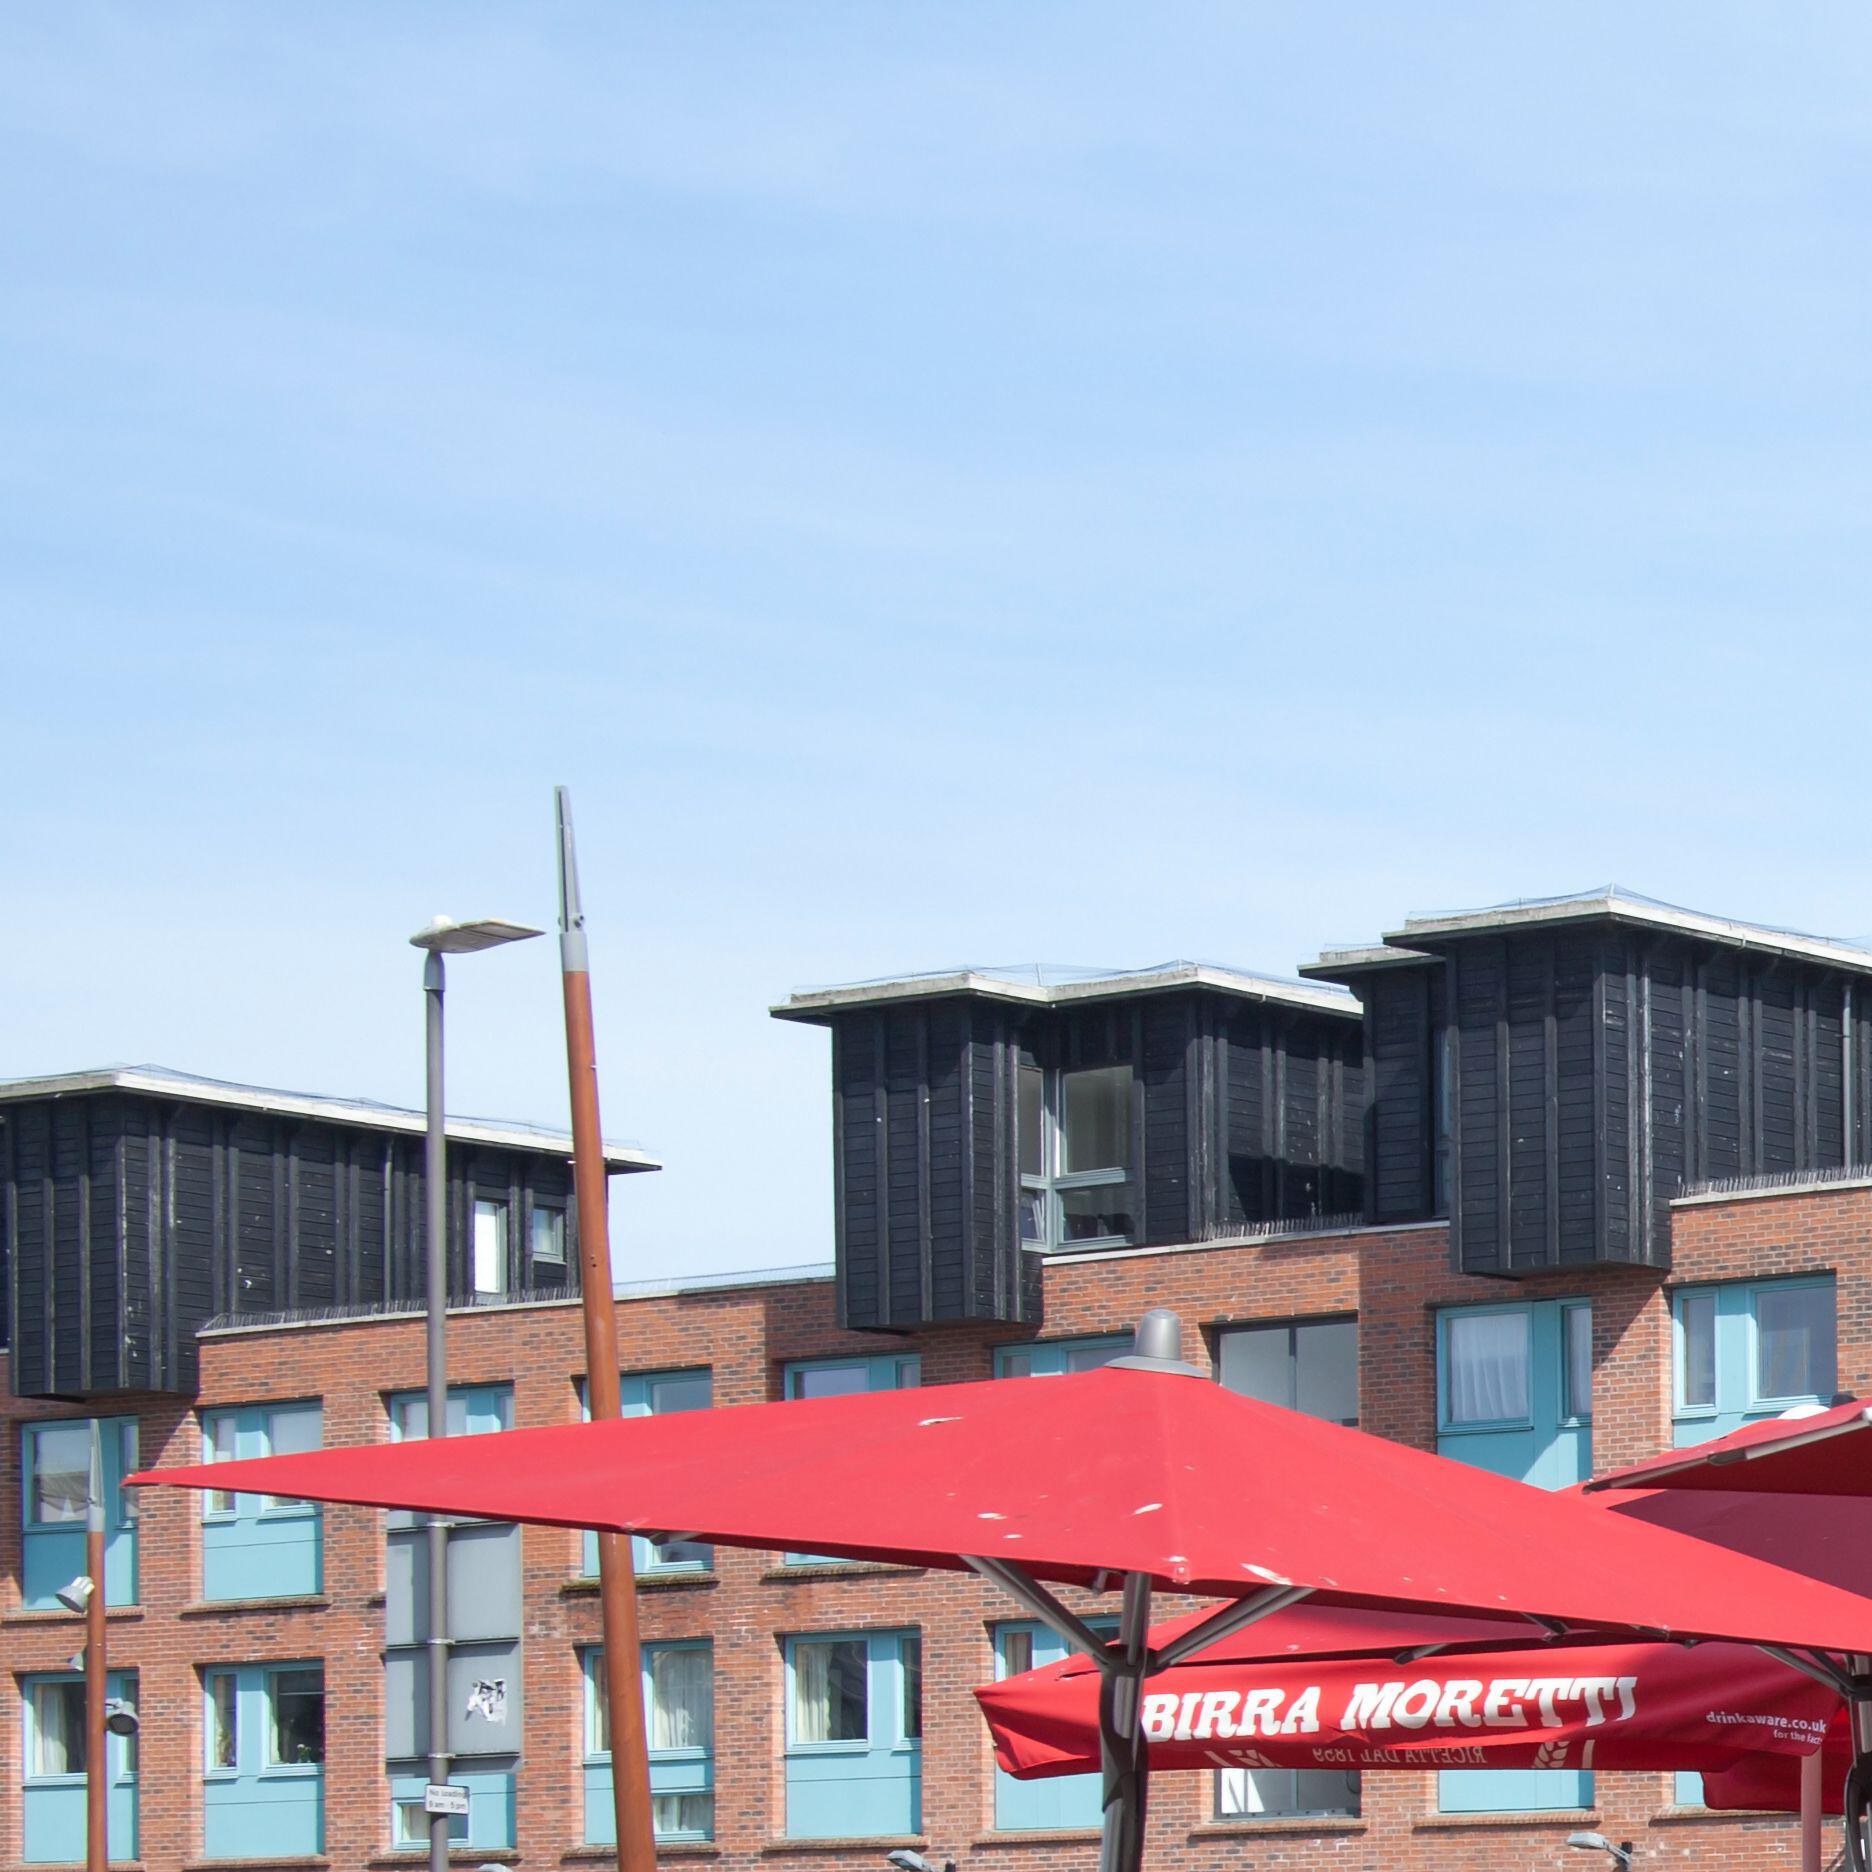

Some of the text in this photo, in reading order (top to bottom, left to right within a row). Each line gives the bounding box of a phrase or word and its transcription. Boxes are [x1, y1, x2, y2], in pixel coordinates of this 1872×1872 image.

[1141, 1676, 1638, 1742] BIRRA MORETTI
[1706, 1711, 1828, 1733] drinkaware.co.uk
[1773, 1729, 1788, 1739] for
[1790, 1731, 1806, 1742] the
